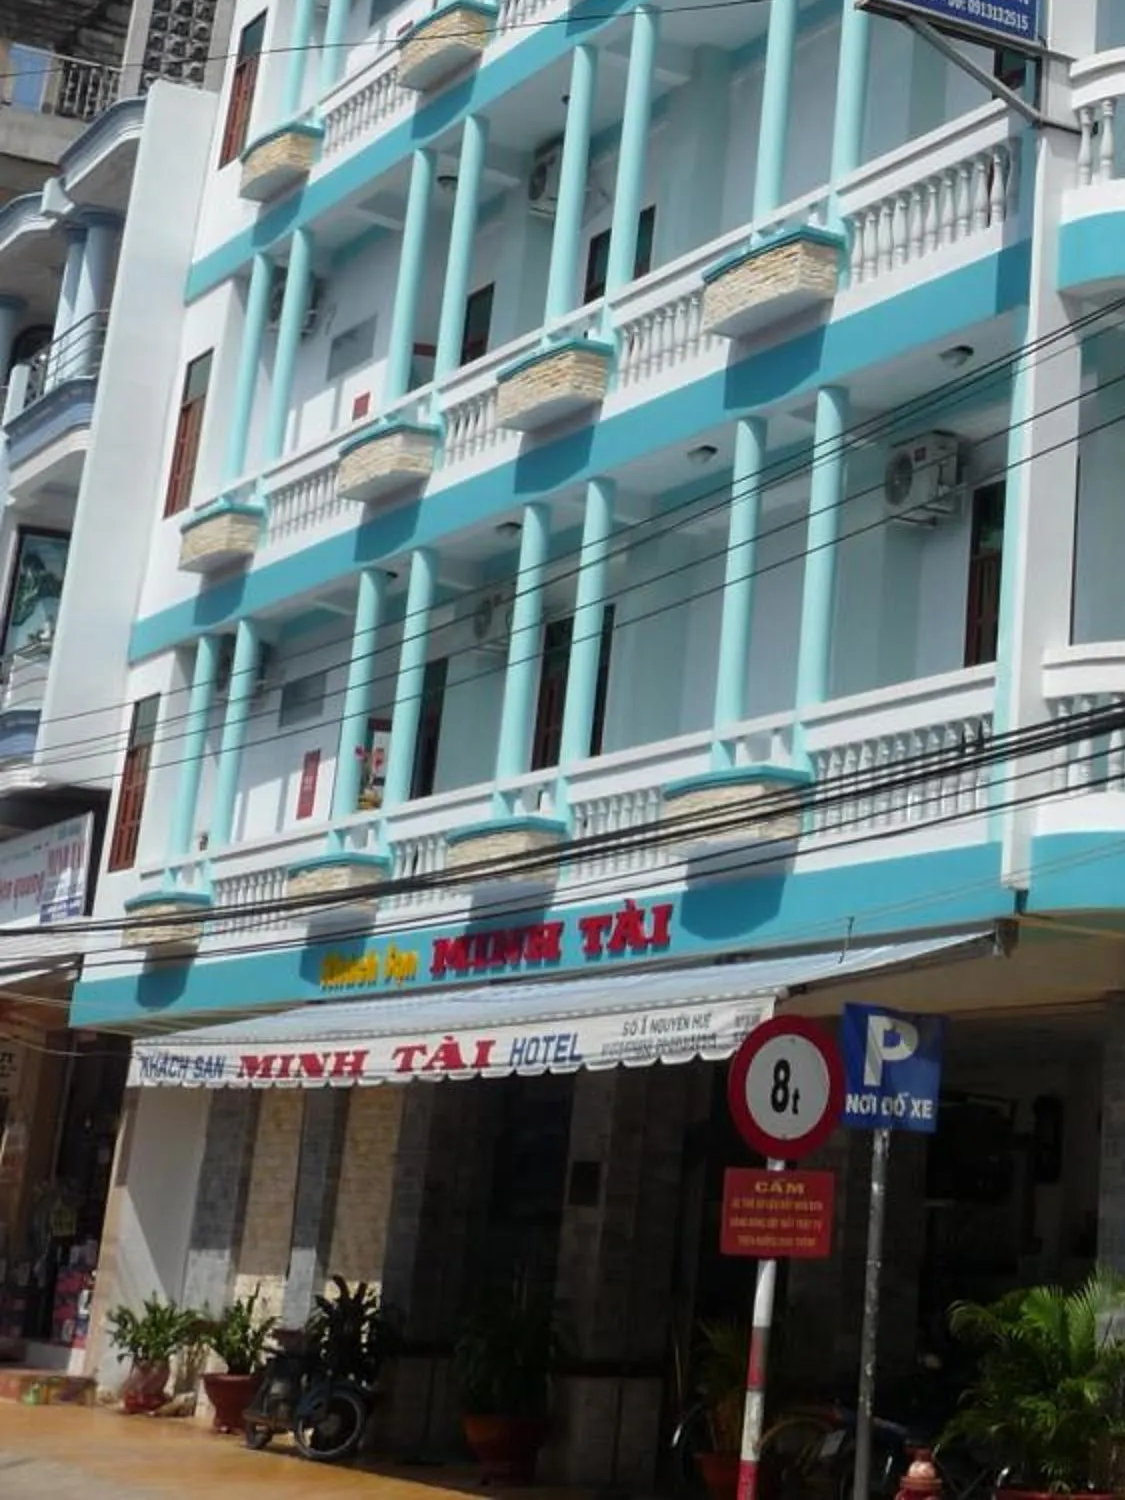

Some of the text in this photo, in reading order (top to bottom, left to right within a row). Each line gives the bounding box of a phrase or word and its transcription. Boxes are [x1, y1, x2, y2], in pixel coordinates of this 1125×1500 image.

[430, 921, 565, 976] MINH
[578, 898, 673, 954] TÀI
[236, 1049, 370, 1079] MINH
[391, 1035, 497, 1073] TÀI
[508, 1032, 585, 1067] HOTEL
[863, 1014, 919, 1087] P
[909, 1098, 934, 1119] XE
